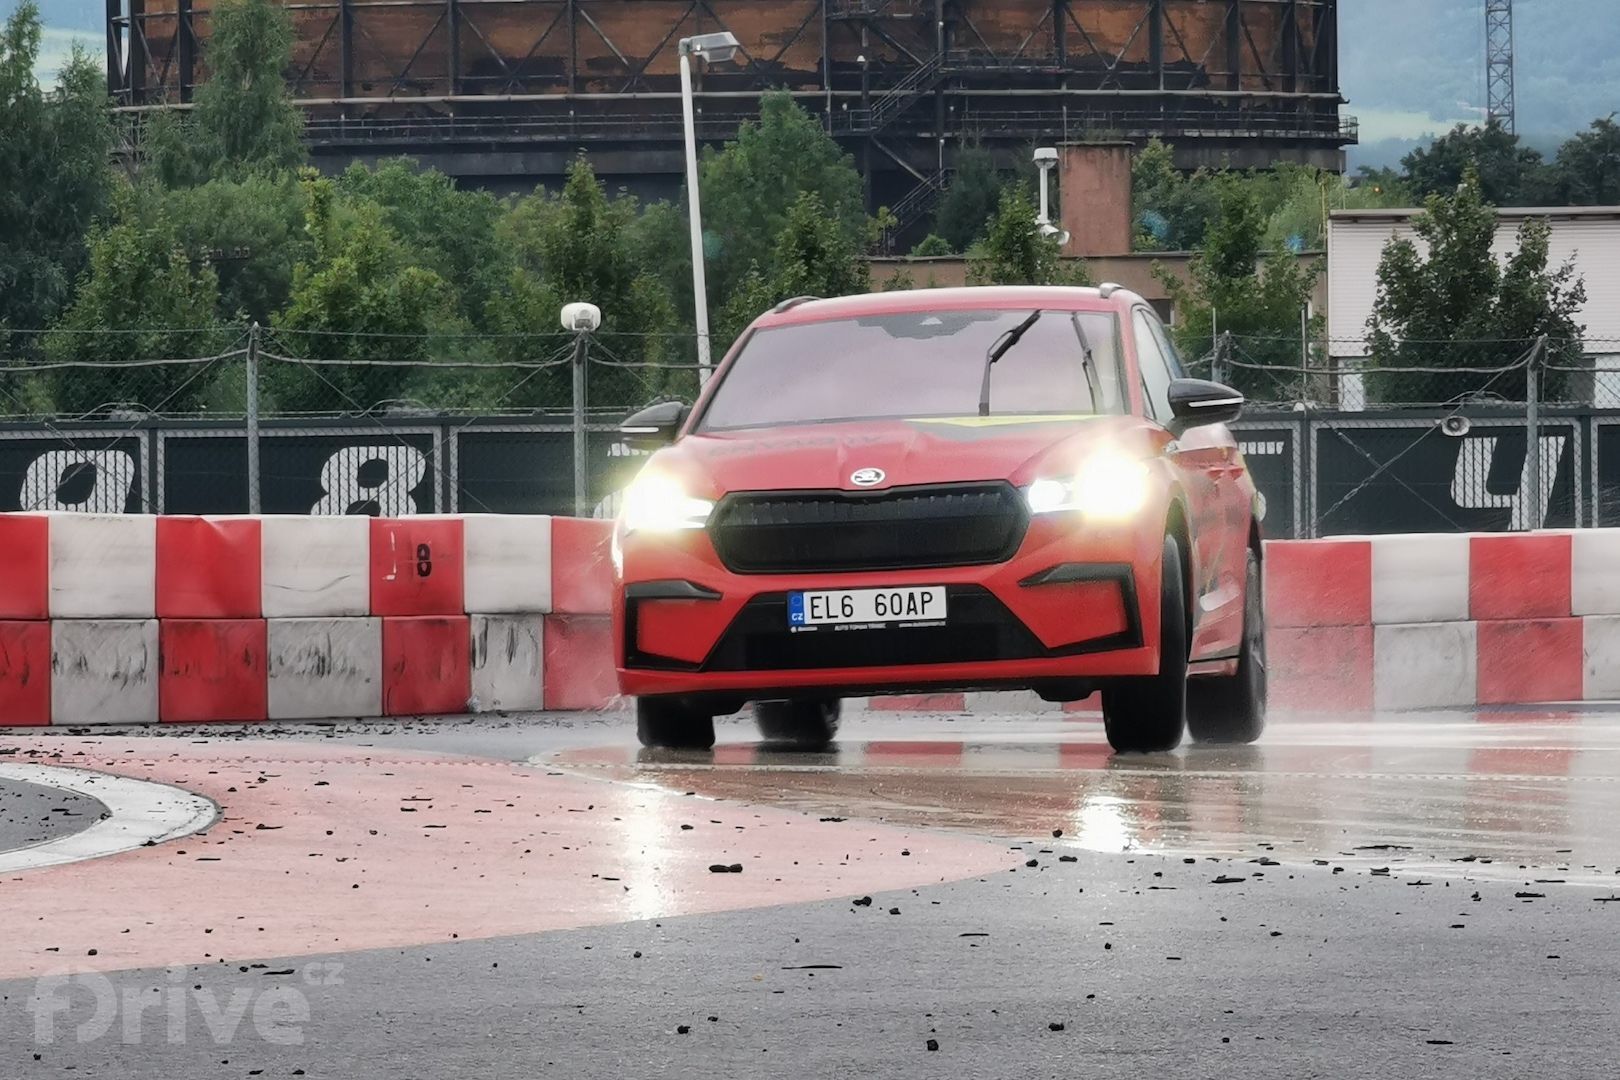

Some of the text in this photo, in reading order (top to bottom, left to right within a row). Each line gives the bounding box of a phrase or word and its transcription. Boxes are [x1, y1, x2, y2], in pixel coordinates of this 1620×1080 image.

[310, 446, 425, 518] 8
[416, 544, 432, 577] 8
[791, 613, 804, 622] CZ
[810, 591, 933, 620] EL6 60AP
